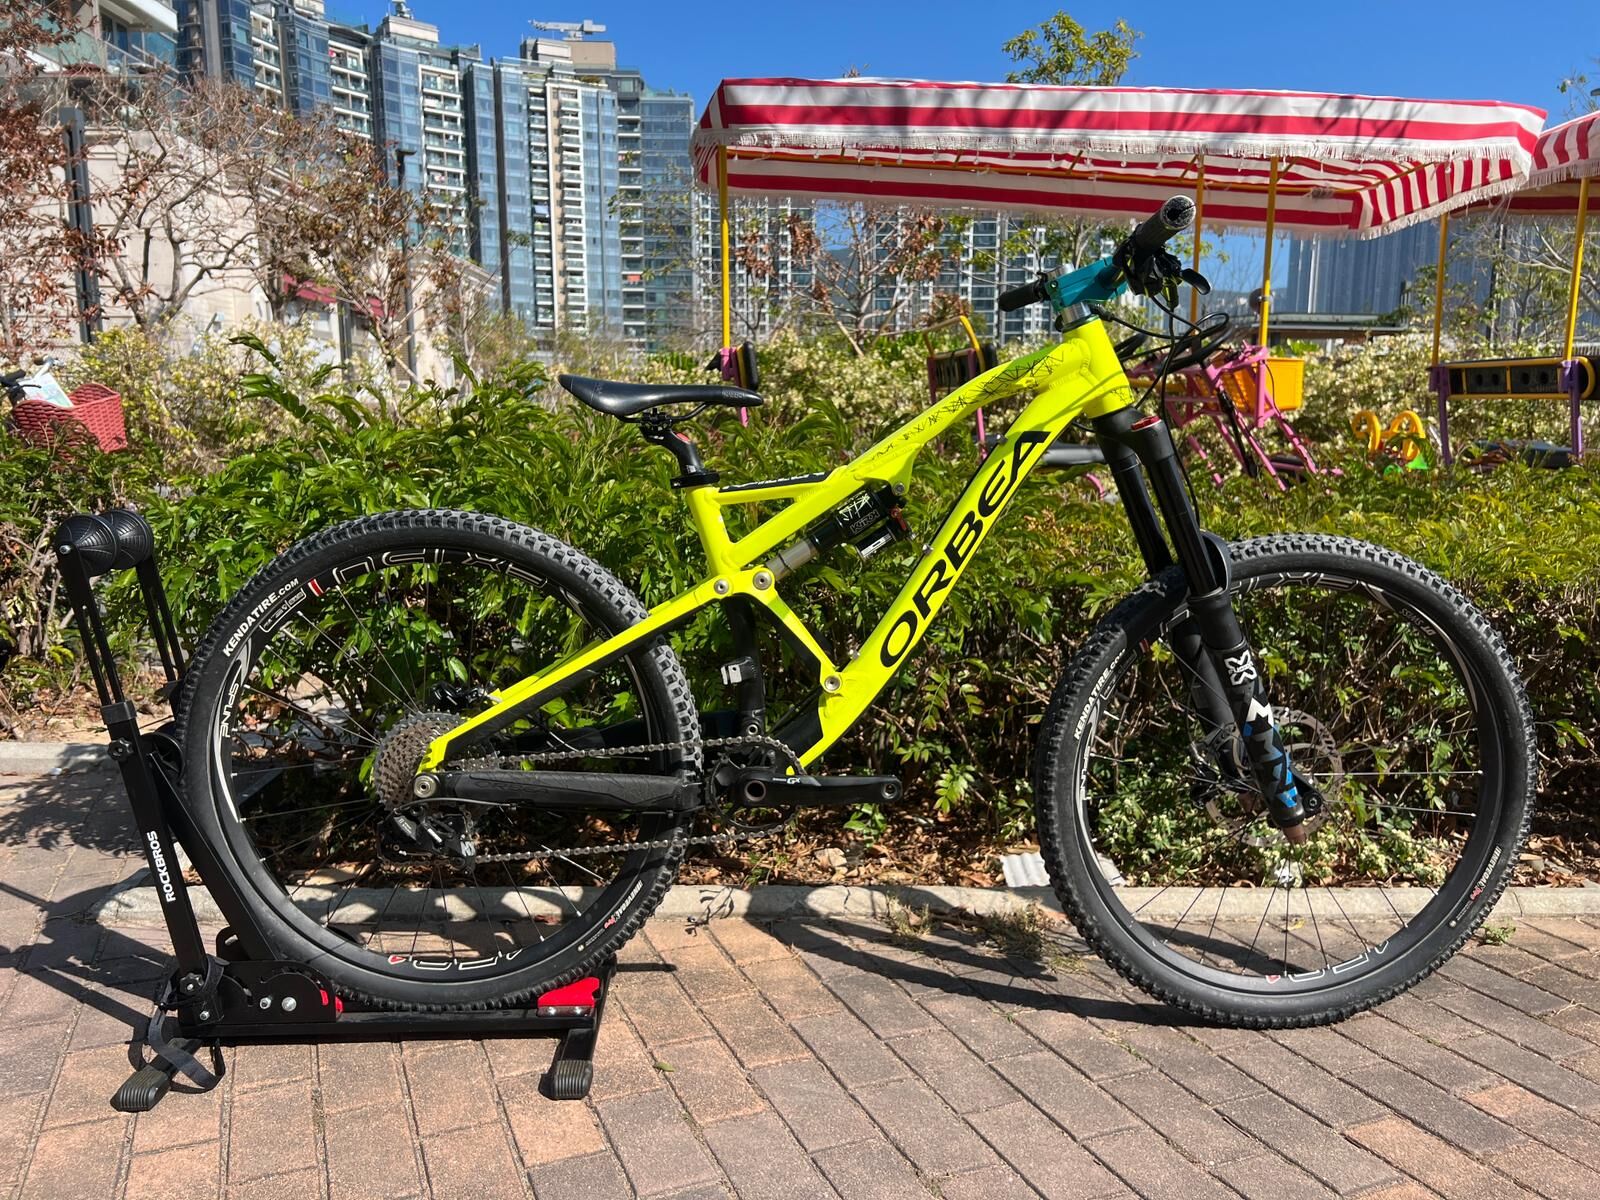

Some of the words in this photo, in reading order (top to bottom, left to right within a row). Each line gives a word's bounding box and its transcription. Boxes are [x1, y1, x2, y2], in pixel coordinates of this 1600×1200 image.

[879, 430, 1051, 668] ORBEA
[223, 578, 299, 657] KENDATIRE.COM
[146, 830, 177, 903] ROCKBROS
